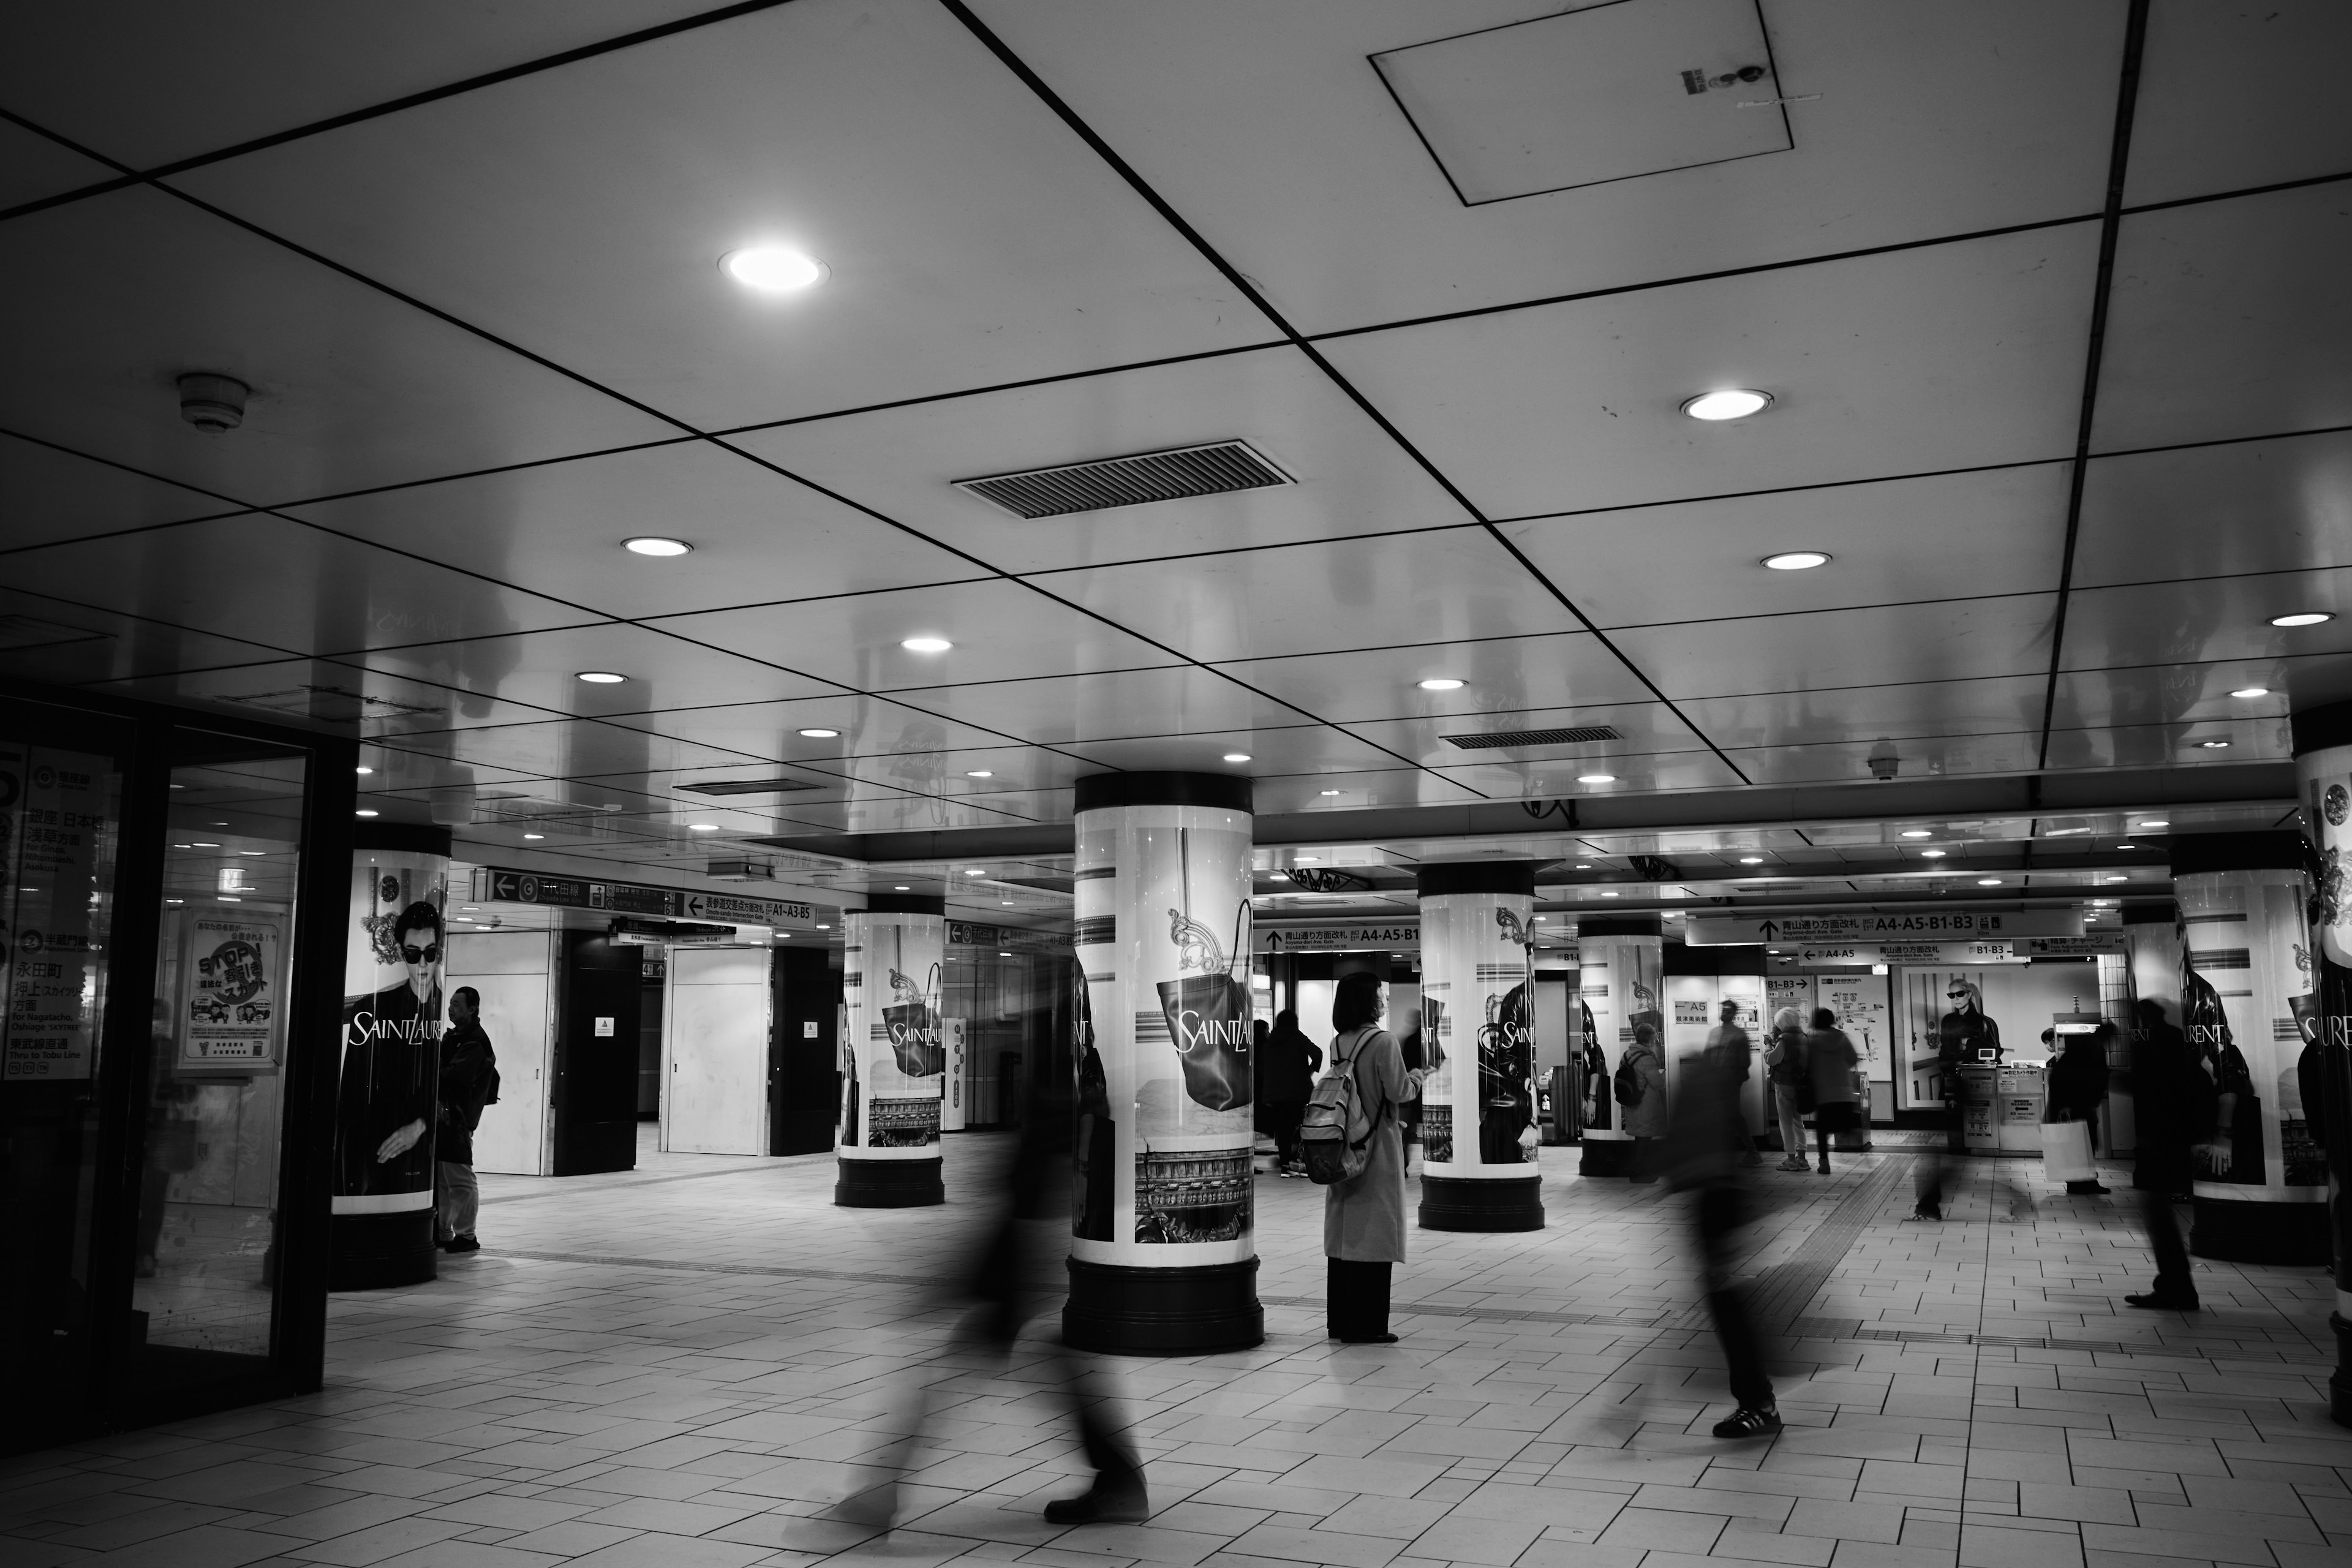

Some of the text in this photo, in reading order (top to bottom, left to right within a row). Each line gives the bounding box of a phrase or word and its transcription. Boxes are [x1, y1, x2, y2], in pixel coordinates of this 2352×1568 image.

[58, 771, 90, 785] 銀座線
[28, 809, 105, 830] 銀座 日本橋
[28, 827, 80, 846] 浅草方面
[26, 843, 66, 854] for Ginza,
[25, 853, 76, 865] Nihombashi,
[24, 863, 59, 873] Asakusa
[540, 880, 579, 896] 千代田線
[706, 897, 764, 913] 表参道交差点方面改札
[1782, 919, 1859, 930] 青山通り方面改札
[1875, 916, 1972, 930] A4·A5·B1·B3
[45, 934, 88, 946] 半蔵門線
[1285, 930, 1348, 940] 青山通り方面改札
[1880, 945, 1940, 954] 青山通り方面改札
[17, 962, 62, 979] 永田町
[224, 961, 260, 983] 客引き
[643, 965, 648, 974] 4
[225, 978, 268, 1000] スカウト
[13, 1000, 37, 1012] 方面
[1691, 1002, 1706, 1011] A5
[28, 1013, 73, 1023] Nagatacho,
[12, 1023, 45, 1033] Oshiage
[349, 1012, 415, 1046] SAINT
[891, 1023, 930, 1046] SAINT
[1174, 1010, 1238, 1054] SAINT
[1501, 1021, 1532, 1048] SAINT
[10, 1038, 68, 1050] 東武線直通
